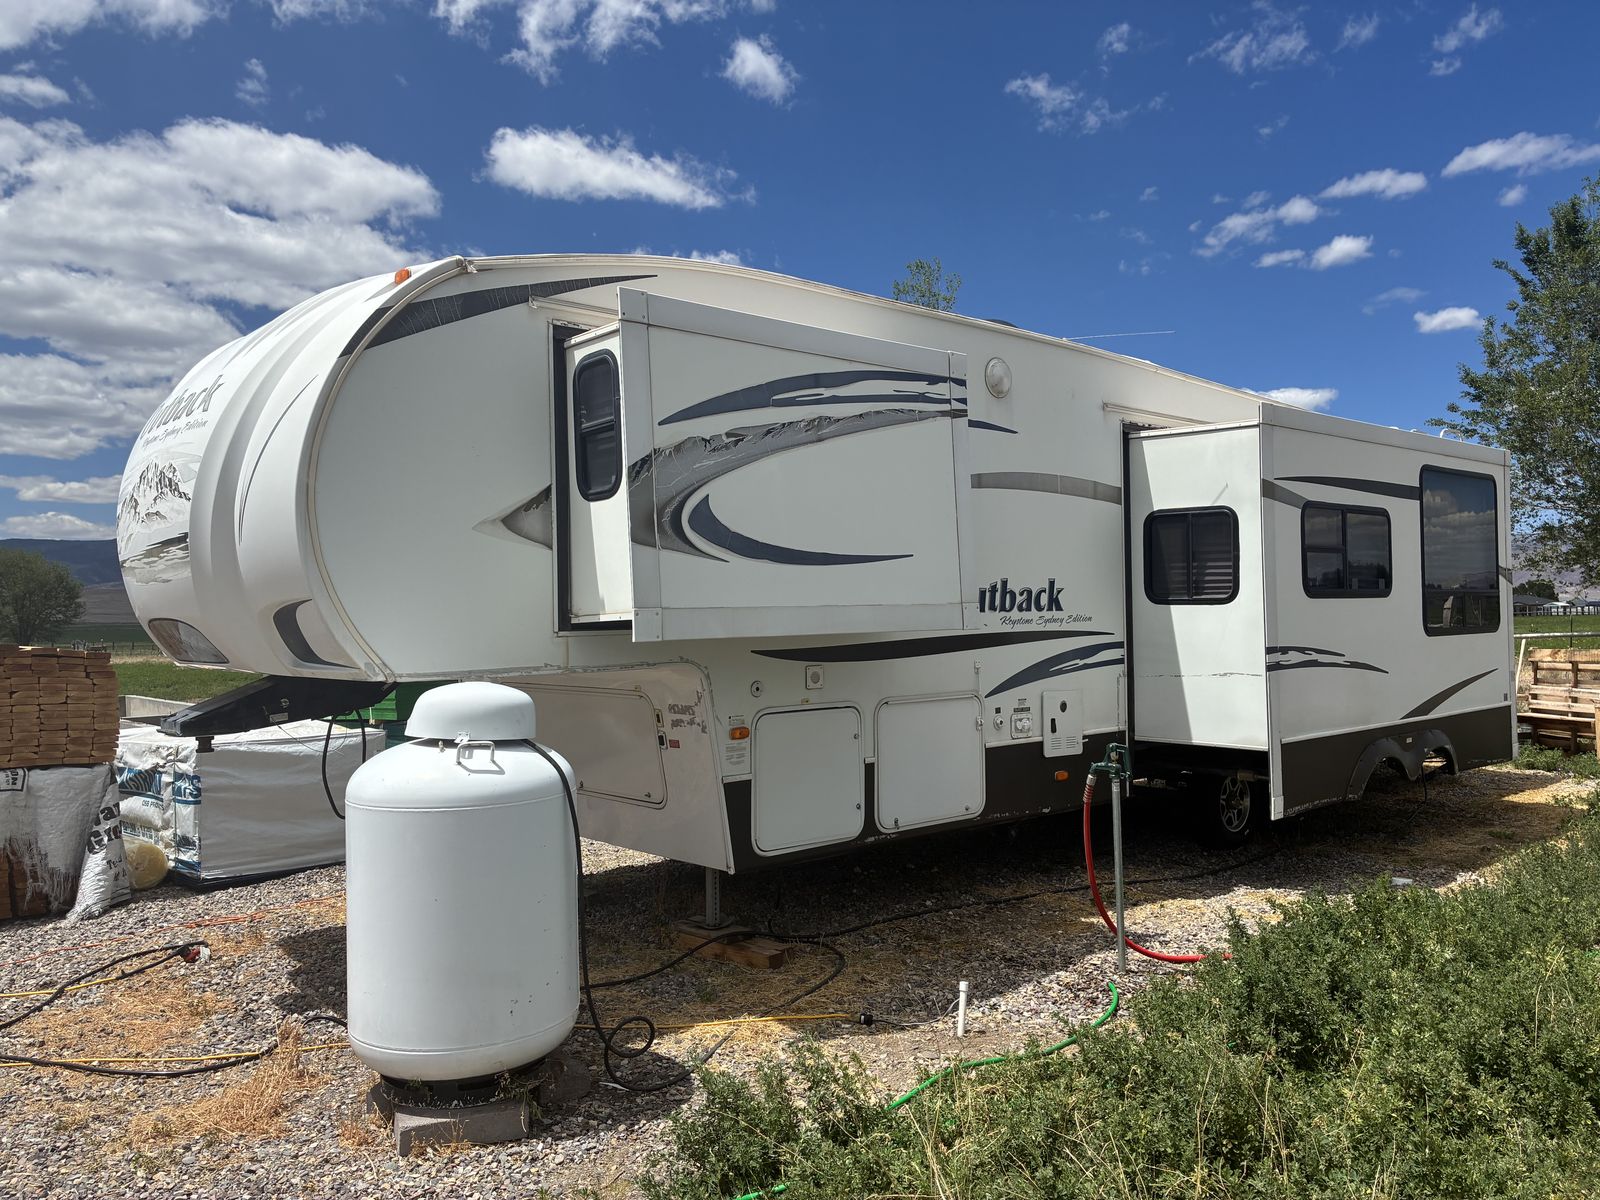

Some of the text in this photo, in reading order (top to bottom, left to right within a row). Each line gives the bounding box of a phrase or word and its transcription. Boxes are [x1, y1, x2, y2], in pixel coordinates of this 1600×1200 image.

[1000, 613, 1093, 629] Keystone Sydney Edition
